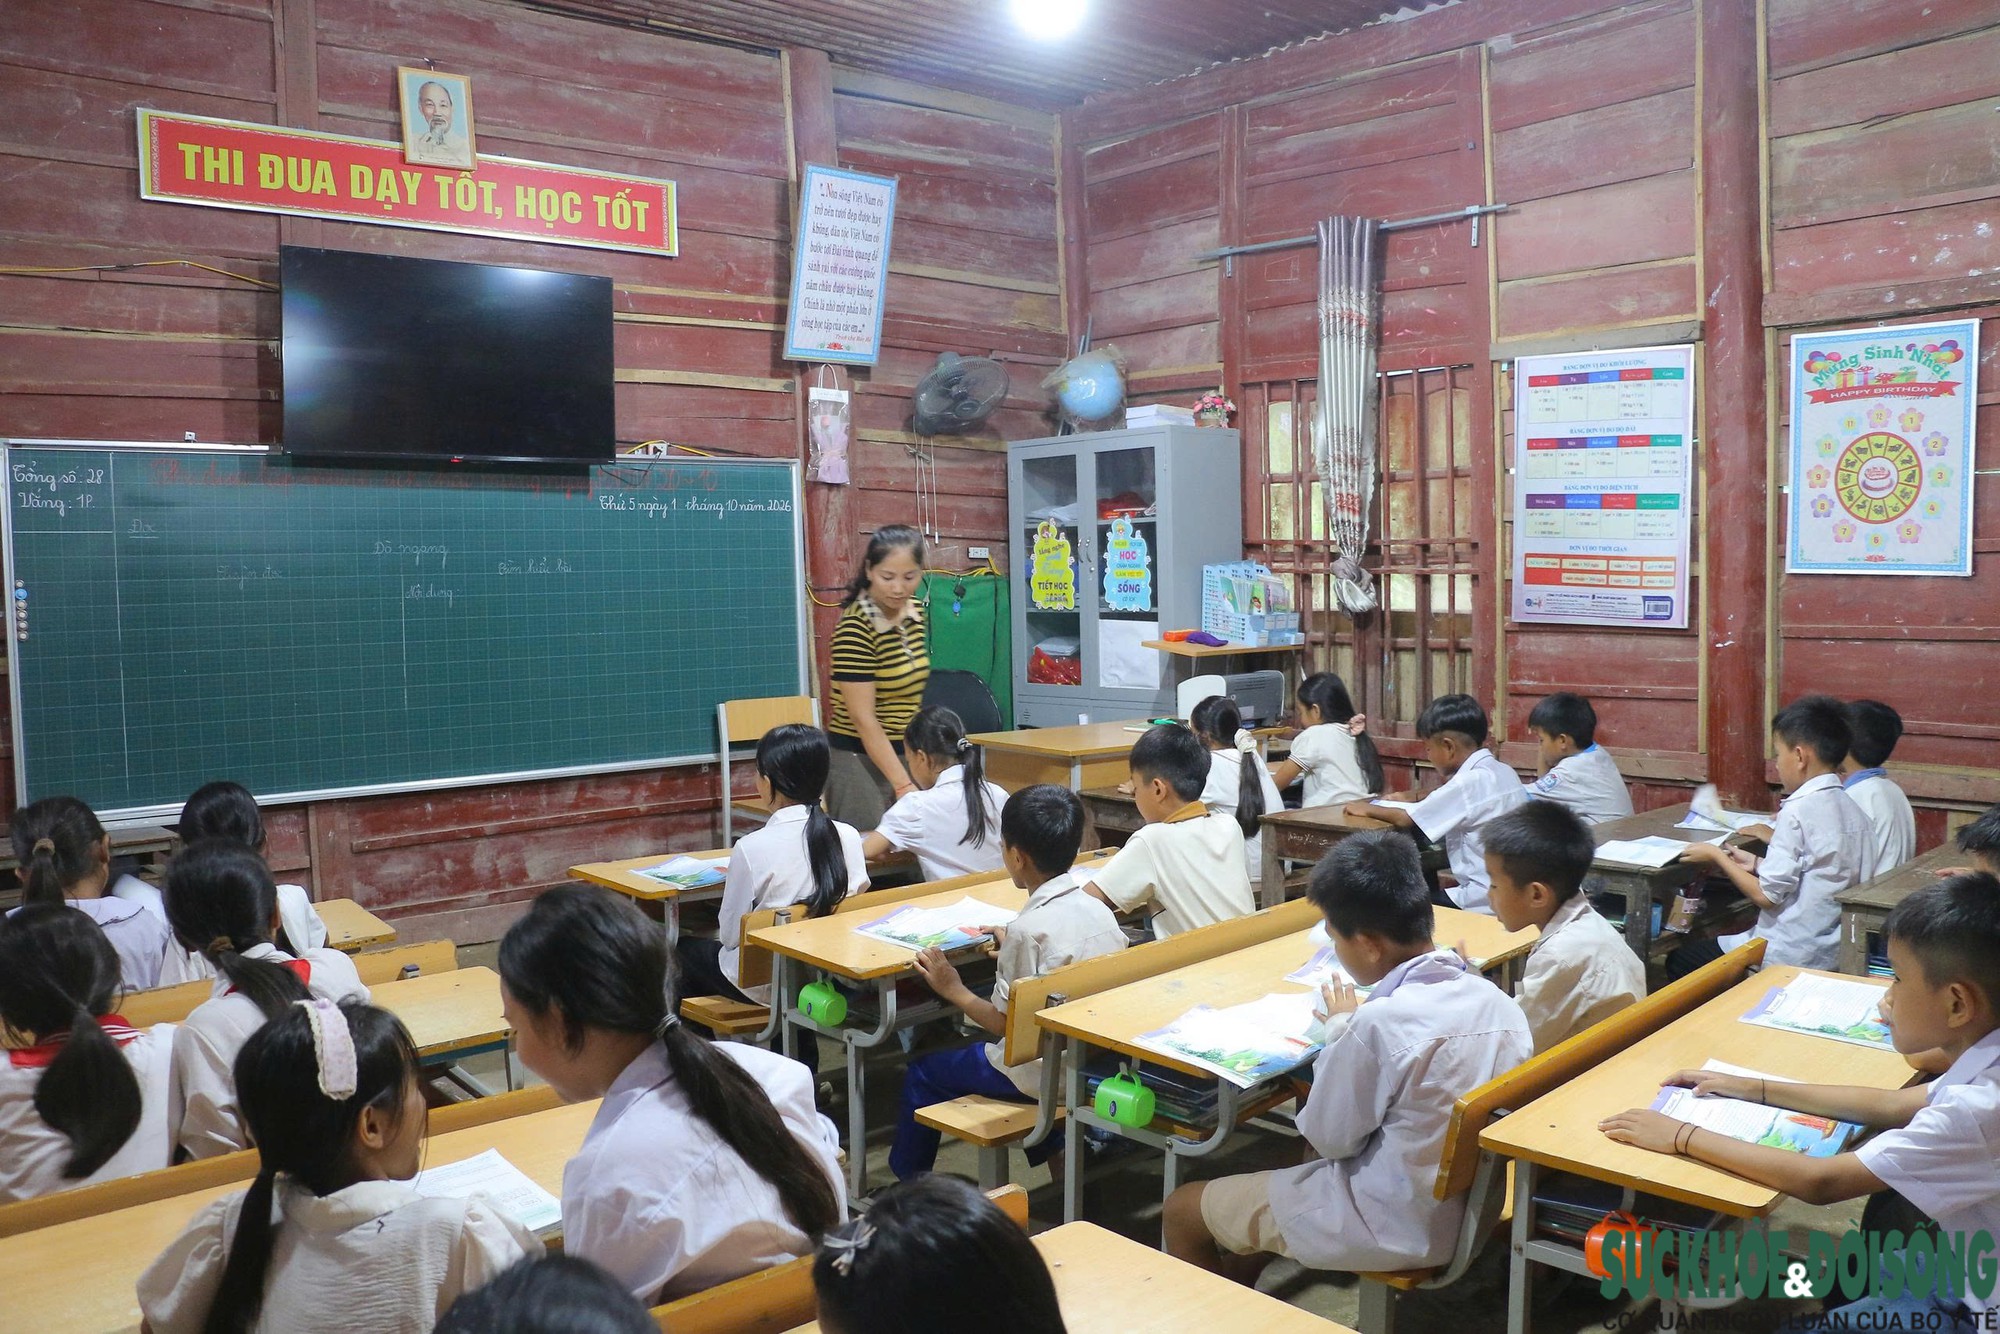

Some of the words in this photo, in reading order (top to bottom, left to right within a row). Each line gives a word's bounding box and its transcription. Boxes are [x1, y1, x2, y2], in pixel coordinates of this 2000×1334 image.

[178, 142, 244, 186] THI
[259, 152, 338, 198] ĐUA
[349, 164, 420, 211] DẠY
[434, 169, 503, 220] TỐT,
[515, 185, 583, 229] HỌC
[593, 187, 650, 233] TỐT
[853, 190, 862, 206] Việt
[864, 193, 876, 206] Nam
[847, 208, 857, 223] đẹp
[872, 212, 881, 227] hay
[830, 225, 840, 237] dân
[851, 227, 860, 243] Việt
[861, 229, 872, 242] Nam
[855, 250, 871, 263] quang
[1865, 345, 1904, 361] Sinh
[1830, 388, 1870, 399] HAPPY
[1873, 386, 1936, 394] BIRTHDAY
[1932, 441, 1938, 449] 2
[12, 460, 56, 492] Tổng
[86, 468, 104, 485] 28
[1938, 471, 1943, 479] 3
[599, 492, 626, 511] Thứ
[629, 498, 636, 511] 5
[638, 495, 668, 519] ngày
[671, 498, 677, 510] 1
[685, 496, 723, 520] tháng
[726, 499, 737, 511] 10
[738, 499, 765, 512] năm
[767, 499, 792, 512] 2026
[1820, 502, 1825, 510] 8
[1906, 528, 1912, 536] 5
[1873, 536, 1879, 544] 6
[399, 544, 448, 569] ngang
[1038, 579, 1052, 590] TIẾT
[1117, 579, 1140, 593] SỐNG
